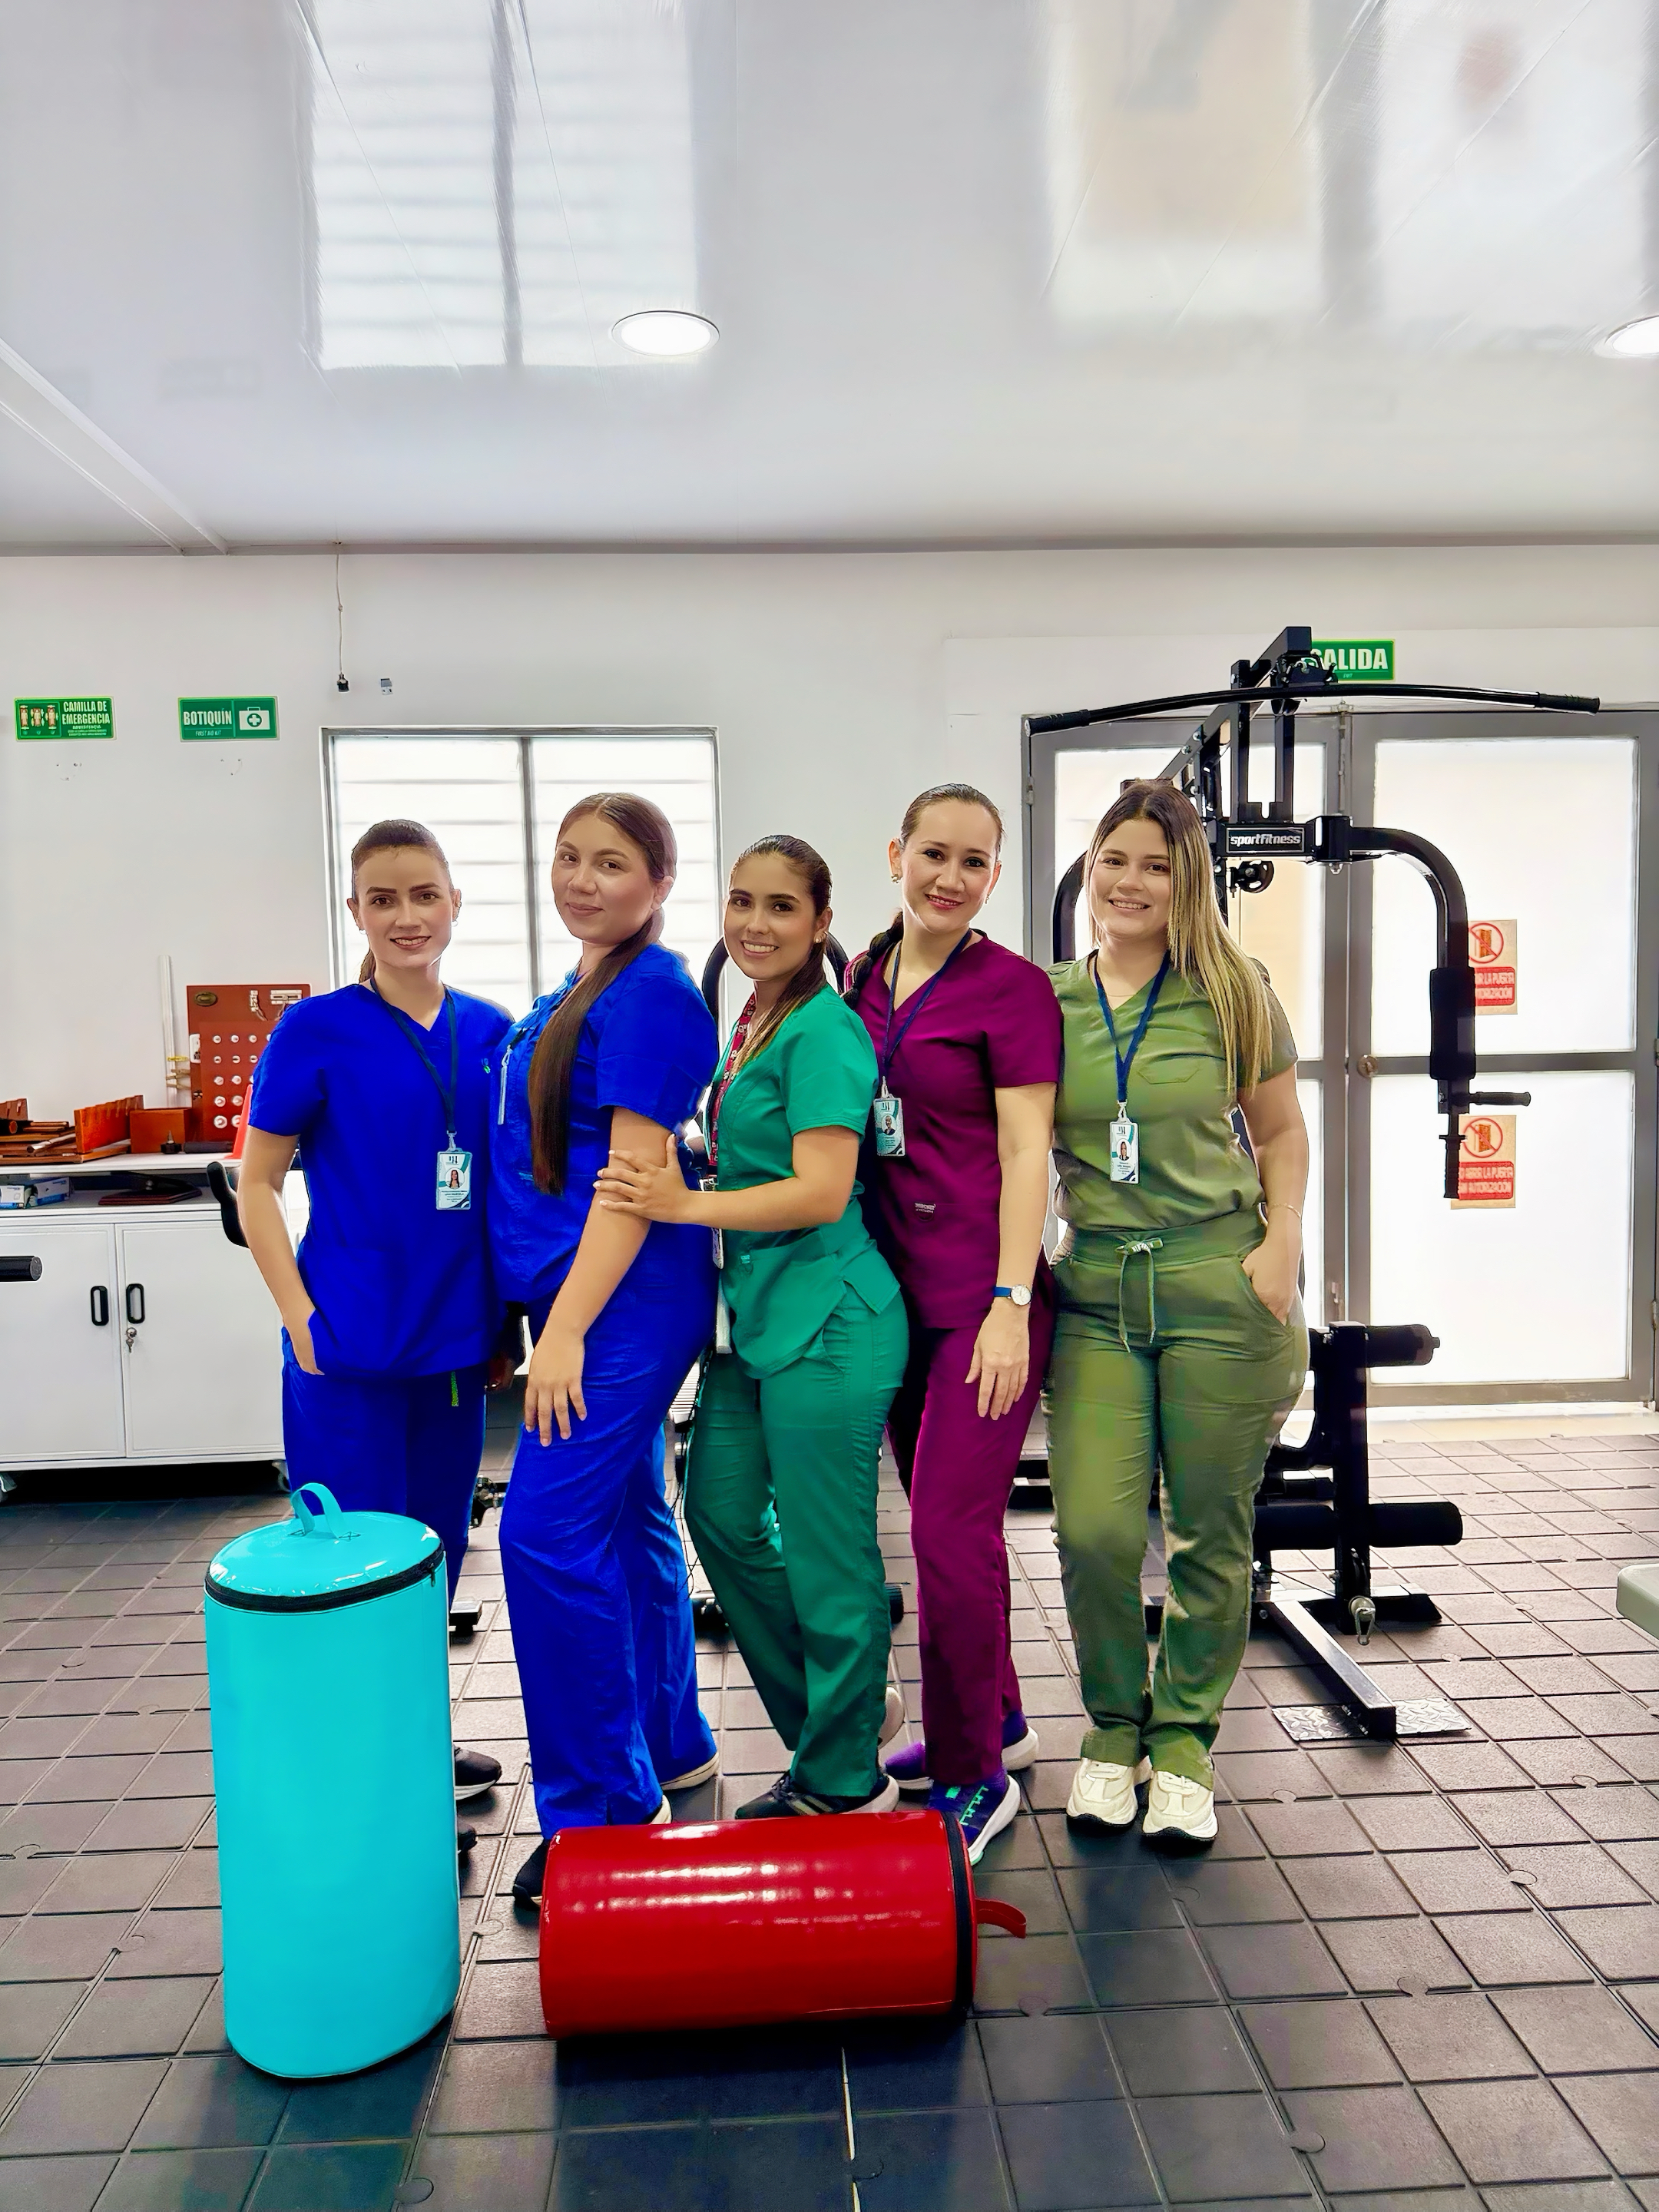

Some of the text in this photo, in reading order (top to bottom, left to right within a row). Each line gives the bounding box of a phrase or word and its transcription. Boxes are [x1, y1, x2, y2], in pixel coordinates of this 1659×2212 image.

[63, 700, 108, 713] CAMILLA DE
[61, 714, 111, 725] EMERGENCIA
[183, 707, 233, 727] BOTIQUÍN
[1230, 833, 1301, 847] sportfitness
